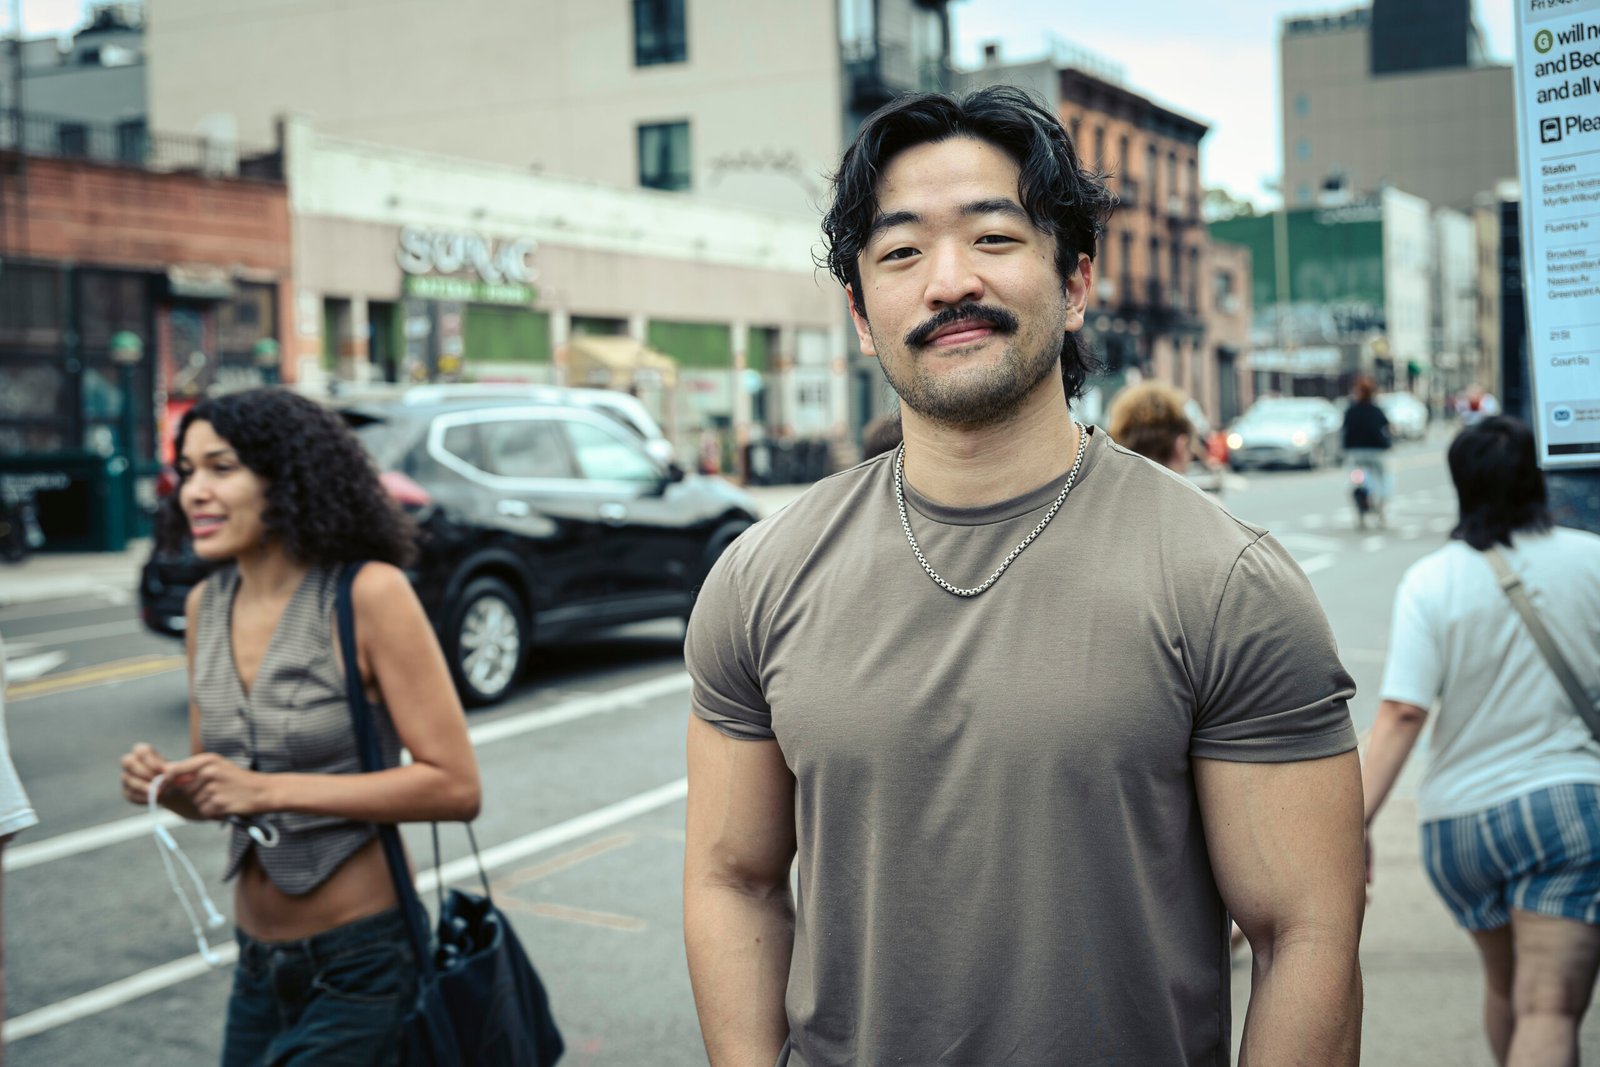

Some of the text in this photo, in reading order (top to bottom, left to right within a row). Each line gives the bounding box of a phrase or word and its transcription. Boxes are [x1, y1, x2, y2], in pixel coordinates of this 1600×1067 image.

[1557, 22, 1584, 45] will
[1587, 24, 1600, 40] n
[1535, 53, 1567, 77] and
[1537, 80, 1569, 103] and
[1572, 76, 1591, 97] all
[1566, 115, 1600, 135] Plea
[1541, 162, 1577, 176] Station
[1550, 356, 1576, 367] Court
